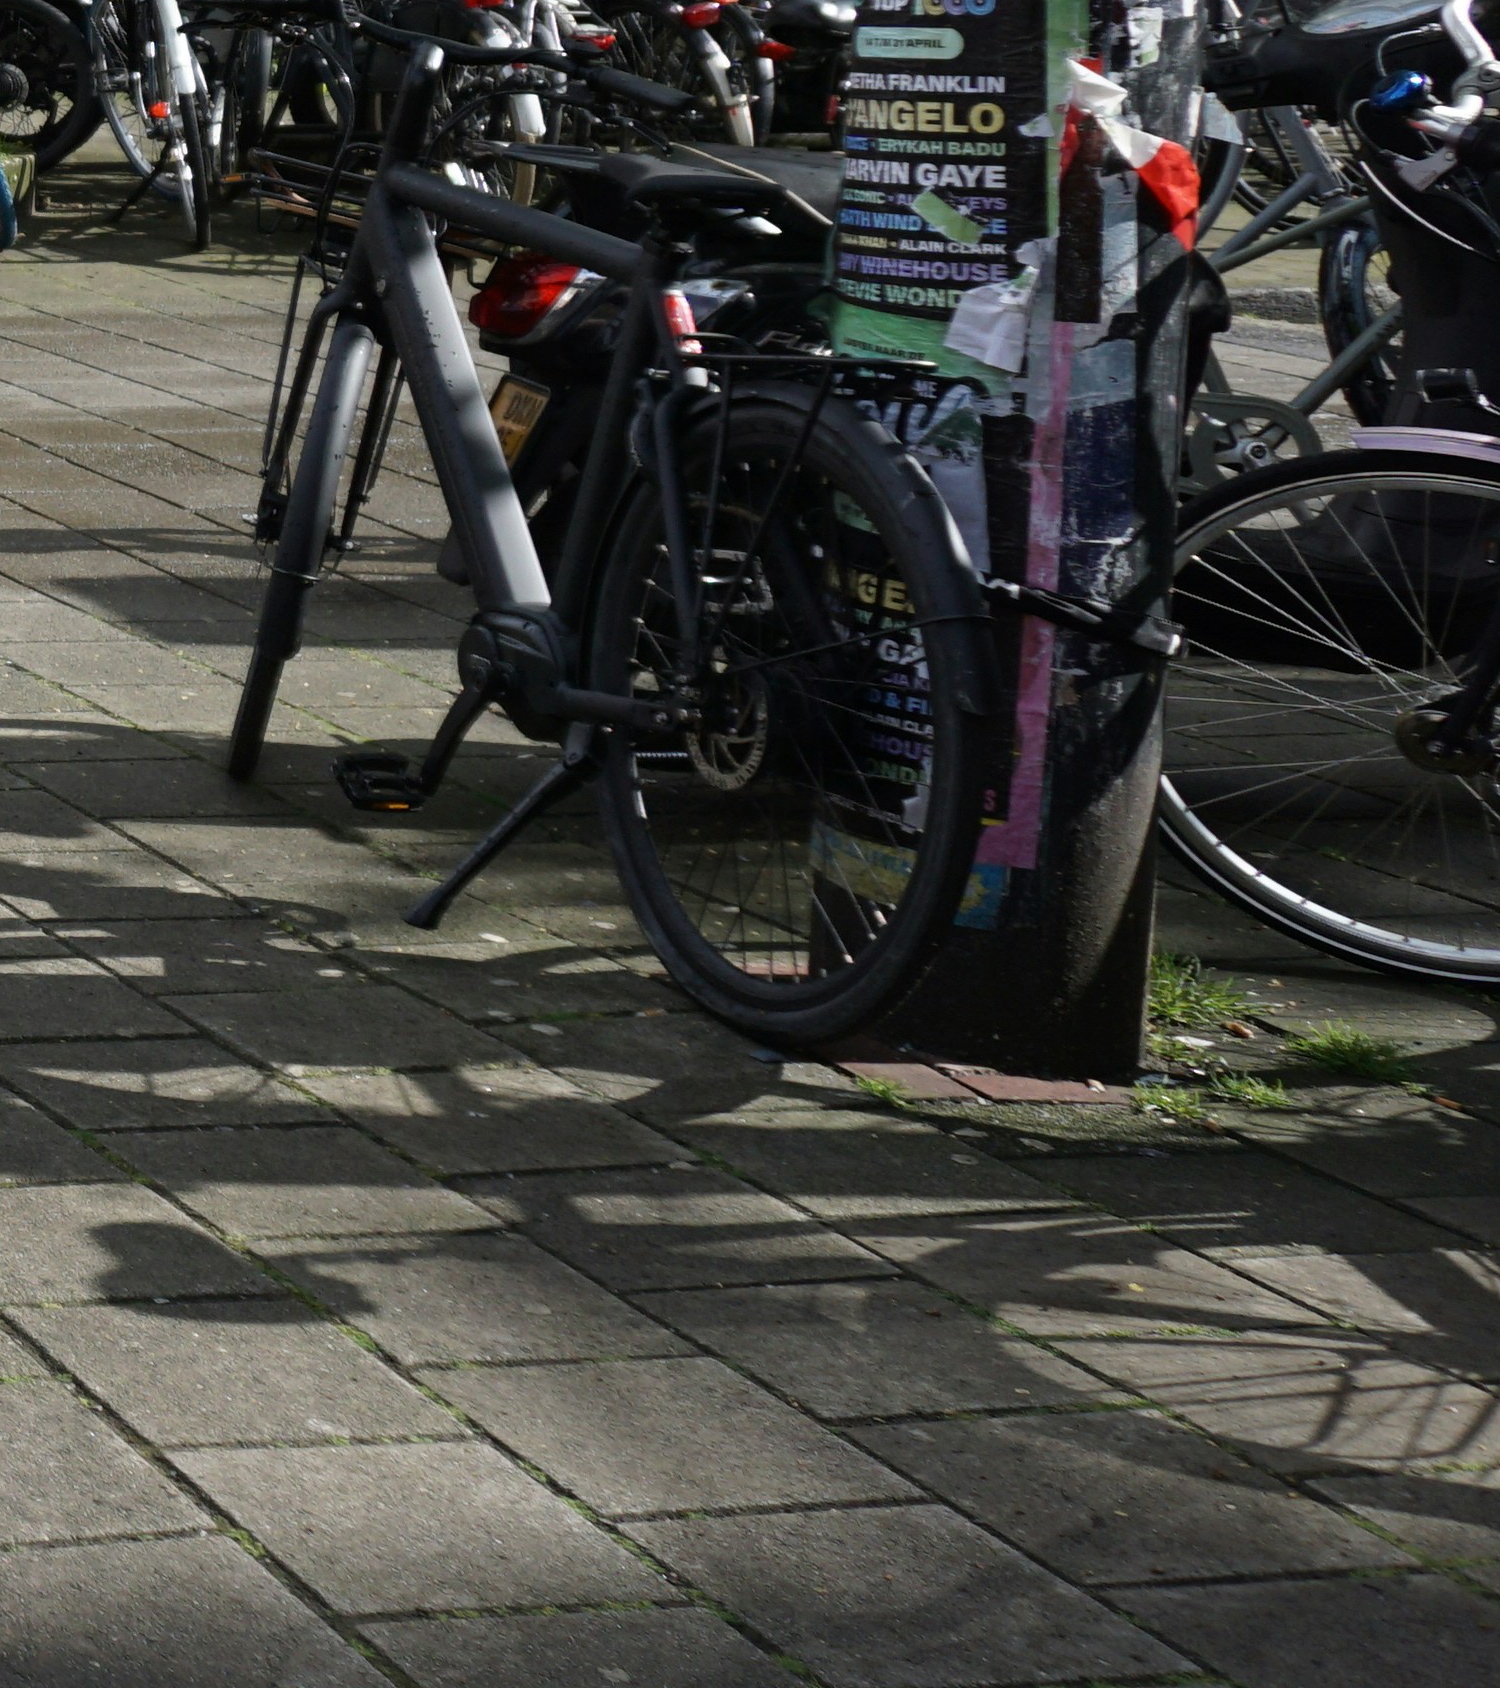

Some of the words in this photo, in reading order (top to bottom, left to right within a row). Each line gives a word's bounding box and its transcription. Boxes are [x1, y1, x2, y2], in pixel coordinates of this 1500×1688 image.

[905, 38, 947, 49] APRIL
[887, 73, 1006, 93] FRANKLIN
[878, 138, 944, 154] ERYKAH
[947, 141, 1007, 156] BADU
[845, 157, 910, 185] ARVIN
[916, 162, 1007, 188] GAYE
[873, 212, 923, 231] WIND
[900, 238, 945, 253] ALAIN
[947, 242, 1008, 255] CLARK
[861, 255, 1009, 282] WINEHOUSE
[883, 284, 964, 308] WOND
